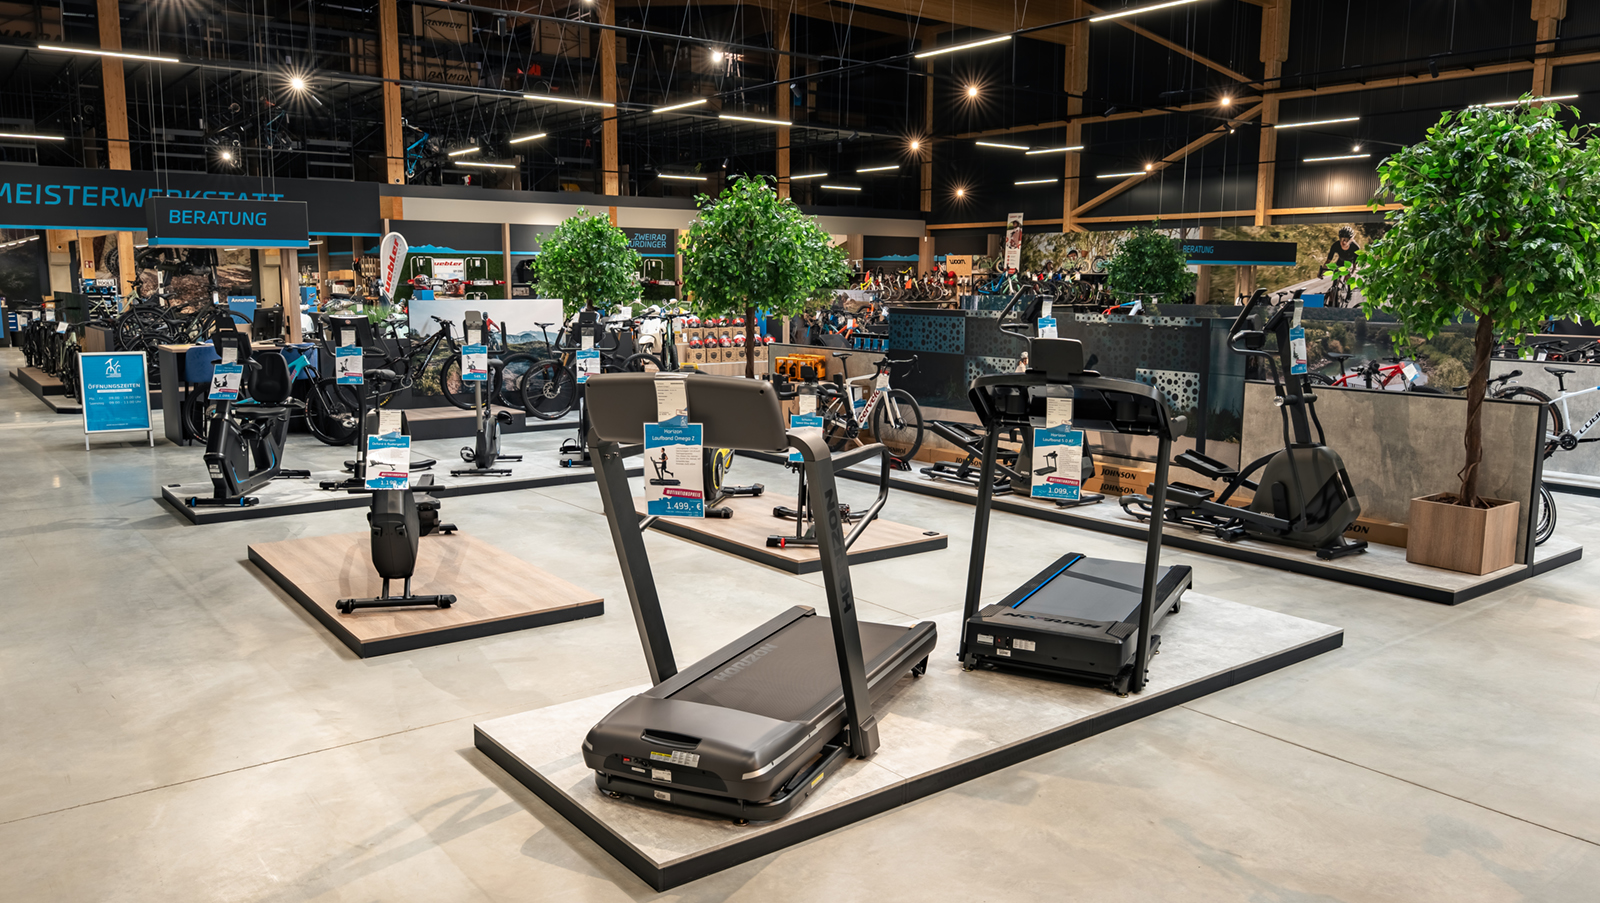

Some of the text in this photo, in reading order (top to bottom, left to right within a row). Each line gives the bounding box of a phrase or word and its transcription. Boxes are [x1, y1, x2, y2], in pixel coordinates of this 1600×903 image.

[169, 209, 267, 226] BERATUNG
[634, 233, 667, 241] ZWEIRAD
[1183, 245, 1214, 253] BERATUNG
[1101, 468, 1137, 480] JOHNSON
[1100, 483, 1136, 494] JOHNSON
[666, 502, 694, 511] 1.499,-
[713, 643, 778, 682] HORIZON
